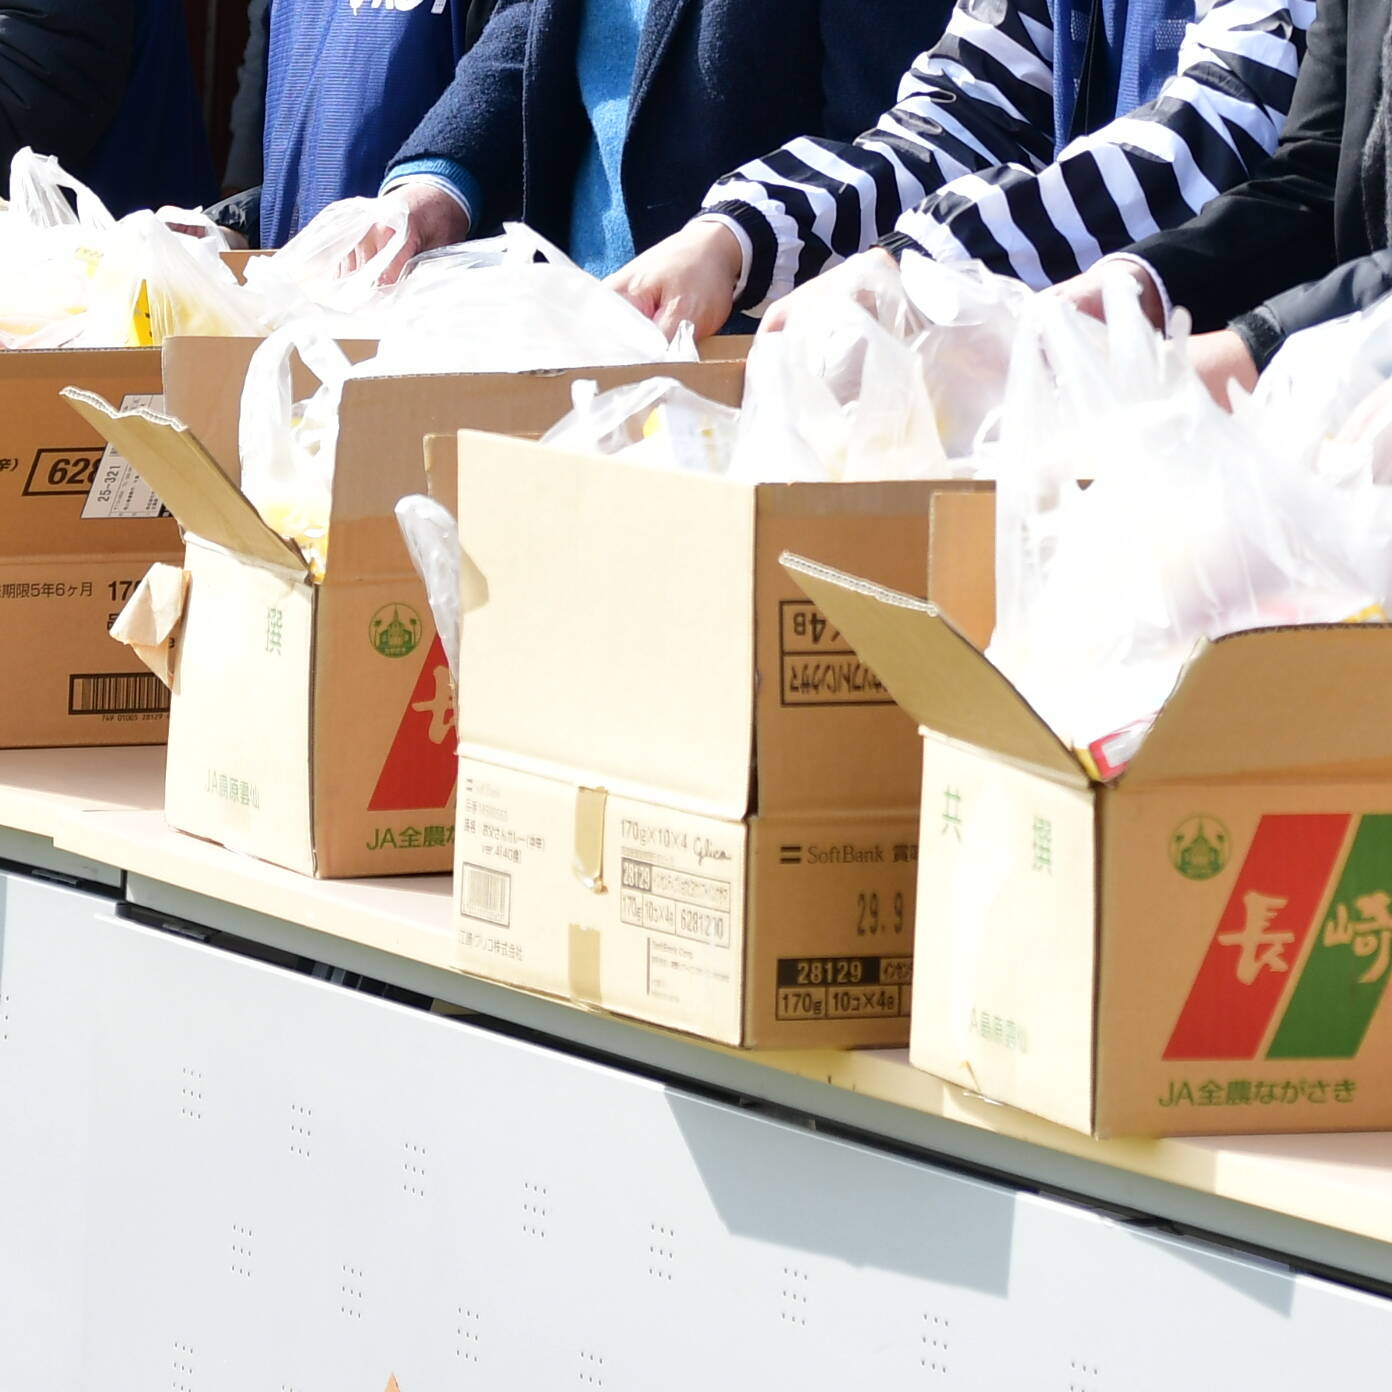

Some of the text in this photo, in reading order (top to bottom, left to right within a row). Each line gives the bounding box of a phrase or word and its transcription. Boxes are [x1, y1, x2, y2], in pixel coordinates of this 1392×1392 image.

[97, 464, 121, 503] 25-321
[108, 580, 141, 601] 17
[693, 836, 732, 866] Glico
[807, 844, 884, 865] SoftBank
[797, 960, 863, 985] 28129
[781, 992, 823, 1016] 170g
[1157, 1078, 1358, 1110] JA全農ながさき
